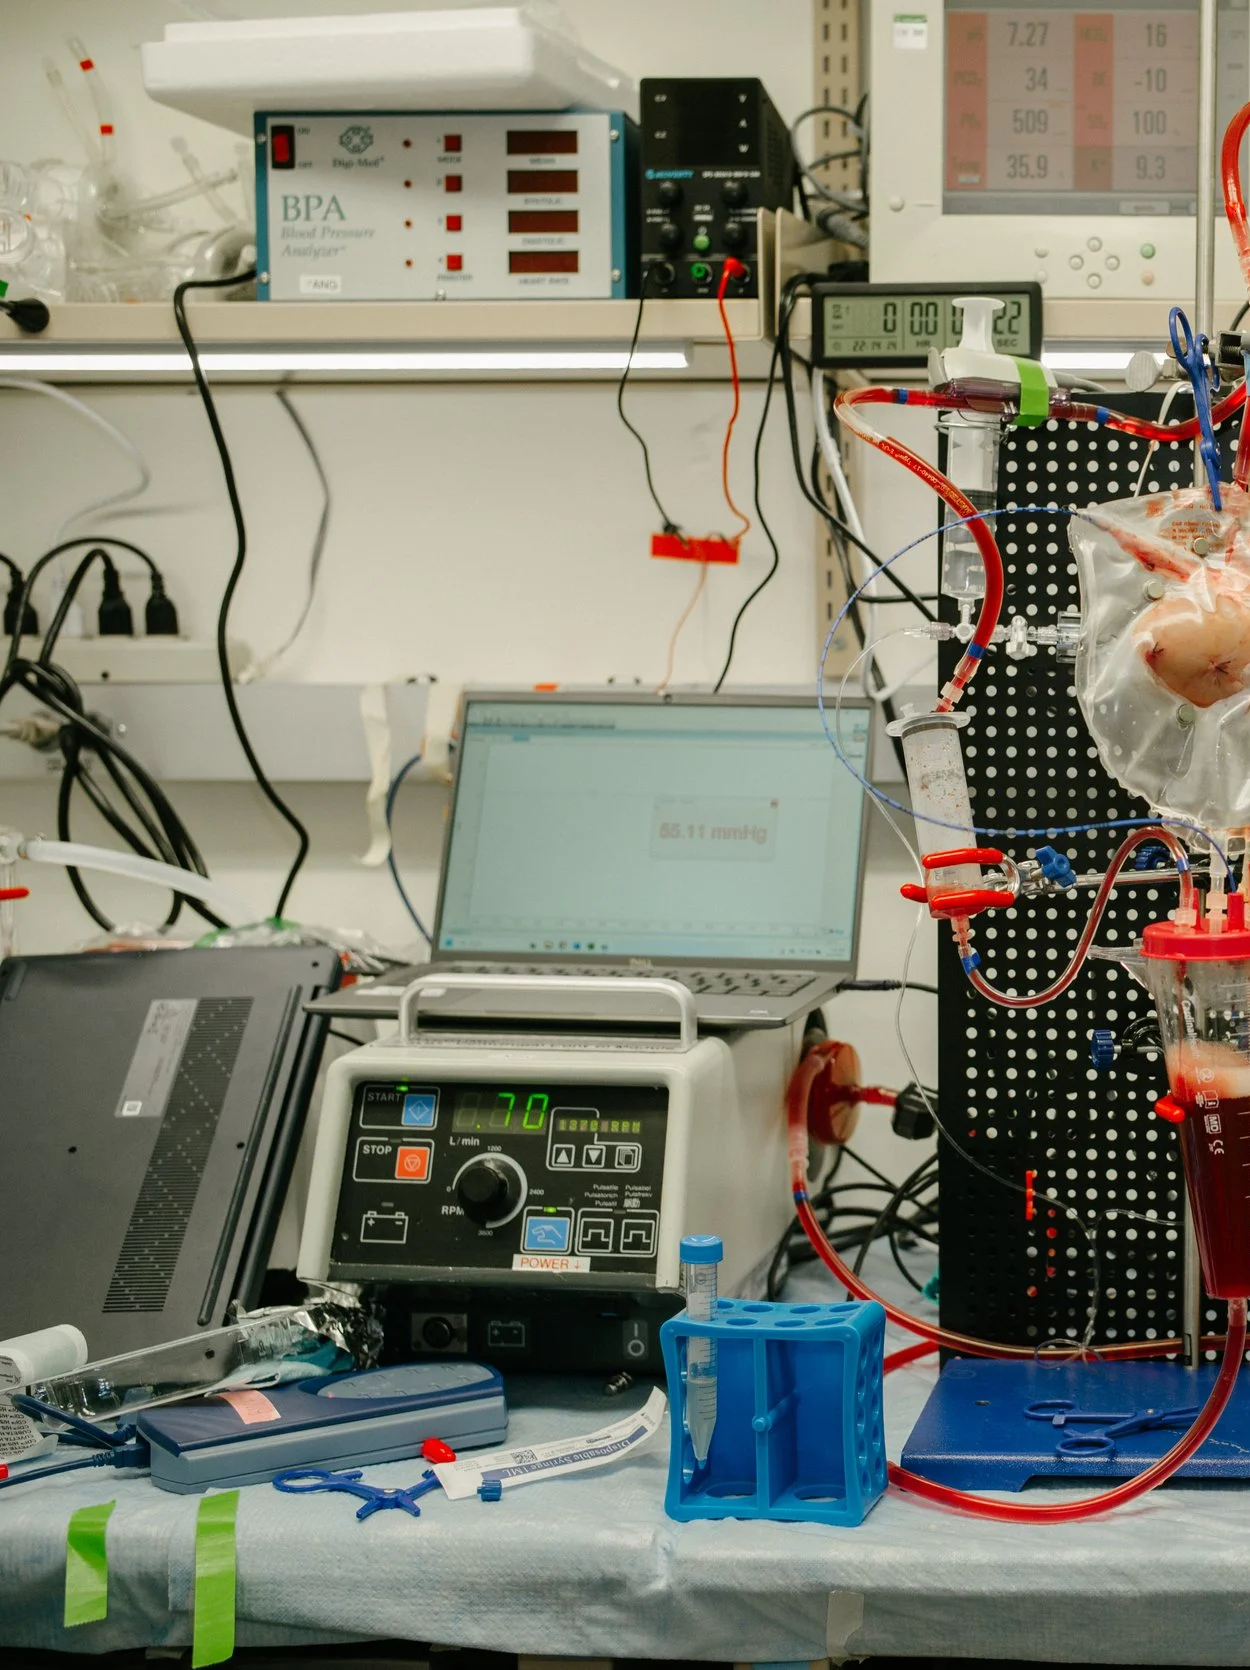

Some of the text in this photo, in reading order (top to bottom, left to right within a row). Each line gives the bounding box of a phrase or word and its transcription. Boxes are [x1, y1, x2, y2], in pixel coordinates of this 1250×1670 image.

[1007, 22, 1049, 47] 7.27
[1145, 23, 1167, 47] 16
[1025, 67, 1048, 92] 34
[1135, 69, 1167, 92] -10
[1012, 109, 1048, 134] 509
[1133, 110, 1167, 135] 100
[1006, 154, 1048, 179] 35.9
[1136, 155, 1166, 180] 9.3
[281, 194, 347, 222] BPA
[281, 226, 376, 240] Blood Pressure
[884, 302, 897, 333] 0
[910, 301, 938, 336] 00
[997, 340, 1018, 348] SEC
[711, 824, 768, 845] mmHg
[367, 1092, 401, 1103] START
[1208, 1115, 1220, 1133] MD
[362, 1144, 392, 1155] STOP
[449, 1136, 480, 1147] L/min
[1213, 1139, 1225, 1155] CE
[441, 1205, 465, 1216] RPM
[520, 1256, 570, 1269] POWER
[578, 1438, 631, 1461] Disposable
[530, 1455, 574, 1471] Syringe
